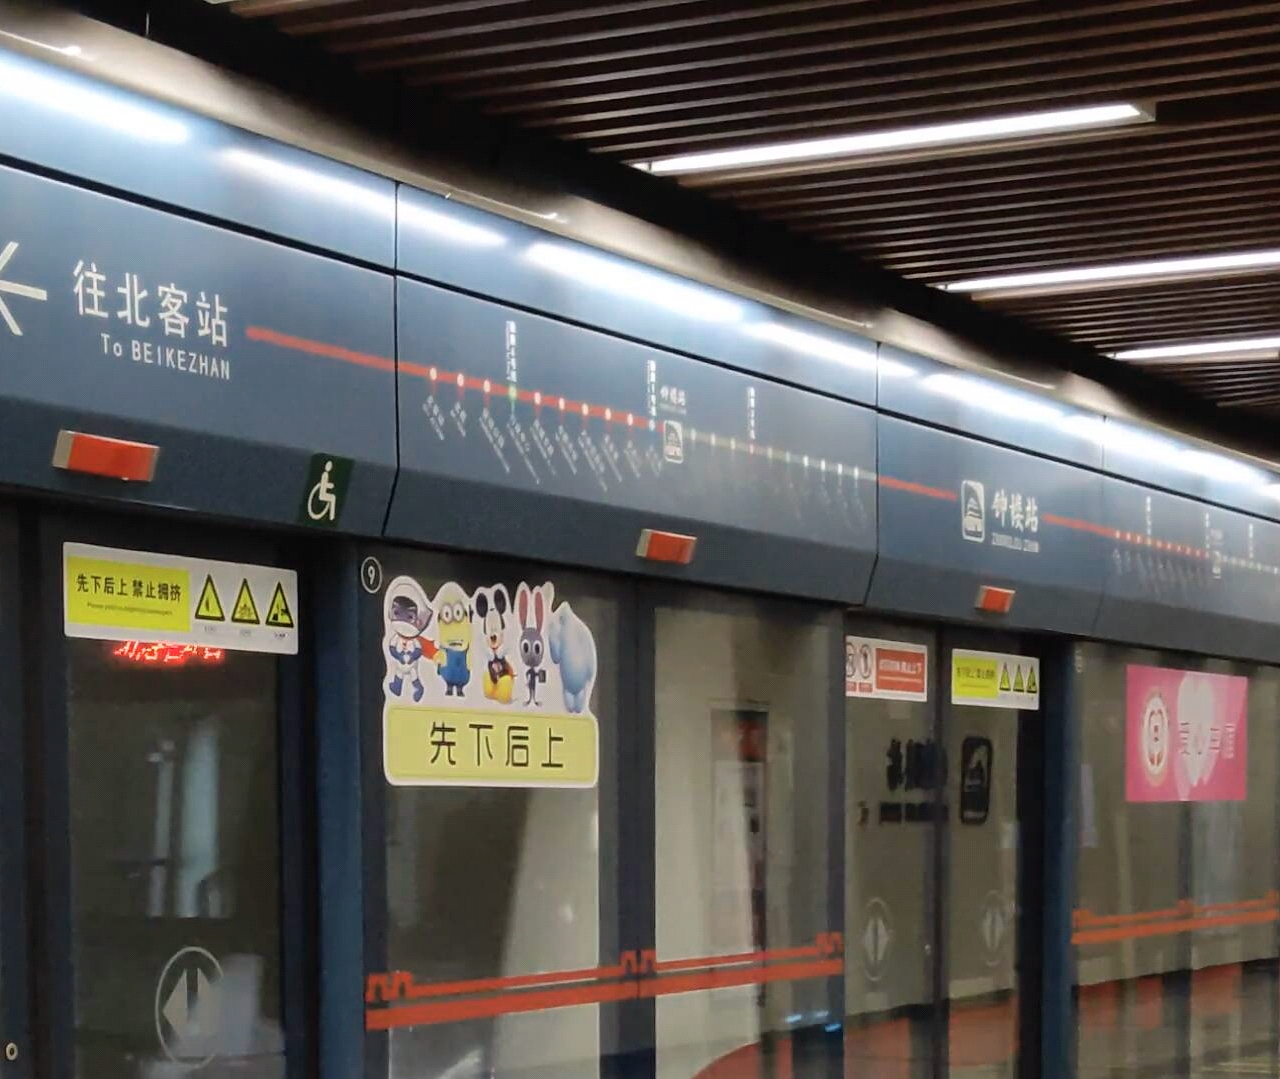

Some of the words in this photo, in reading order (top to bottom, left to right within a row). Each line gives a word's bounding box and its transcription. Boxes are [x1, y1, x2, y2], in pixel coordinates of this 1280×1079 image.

[72, 259, 229, 348] 往北客站
[101, 332, 123, 358] To
[131, 339, 231, 380] BEIKEZHAN
[76, 572, 128, 597] 先下后上
[132, 579, 182, 604] 禁止拥挤
[429, 720, 565, 769] 先下后上
